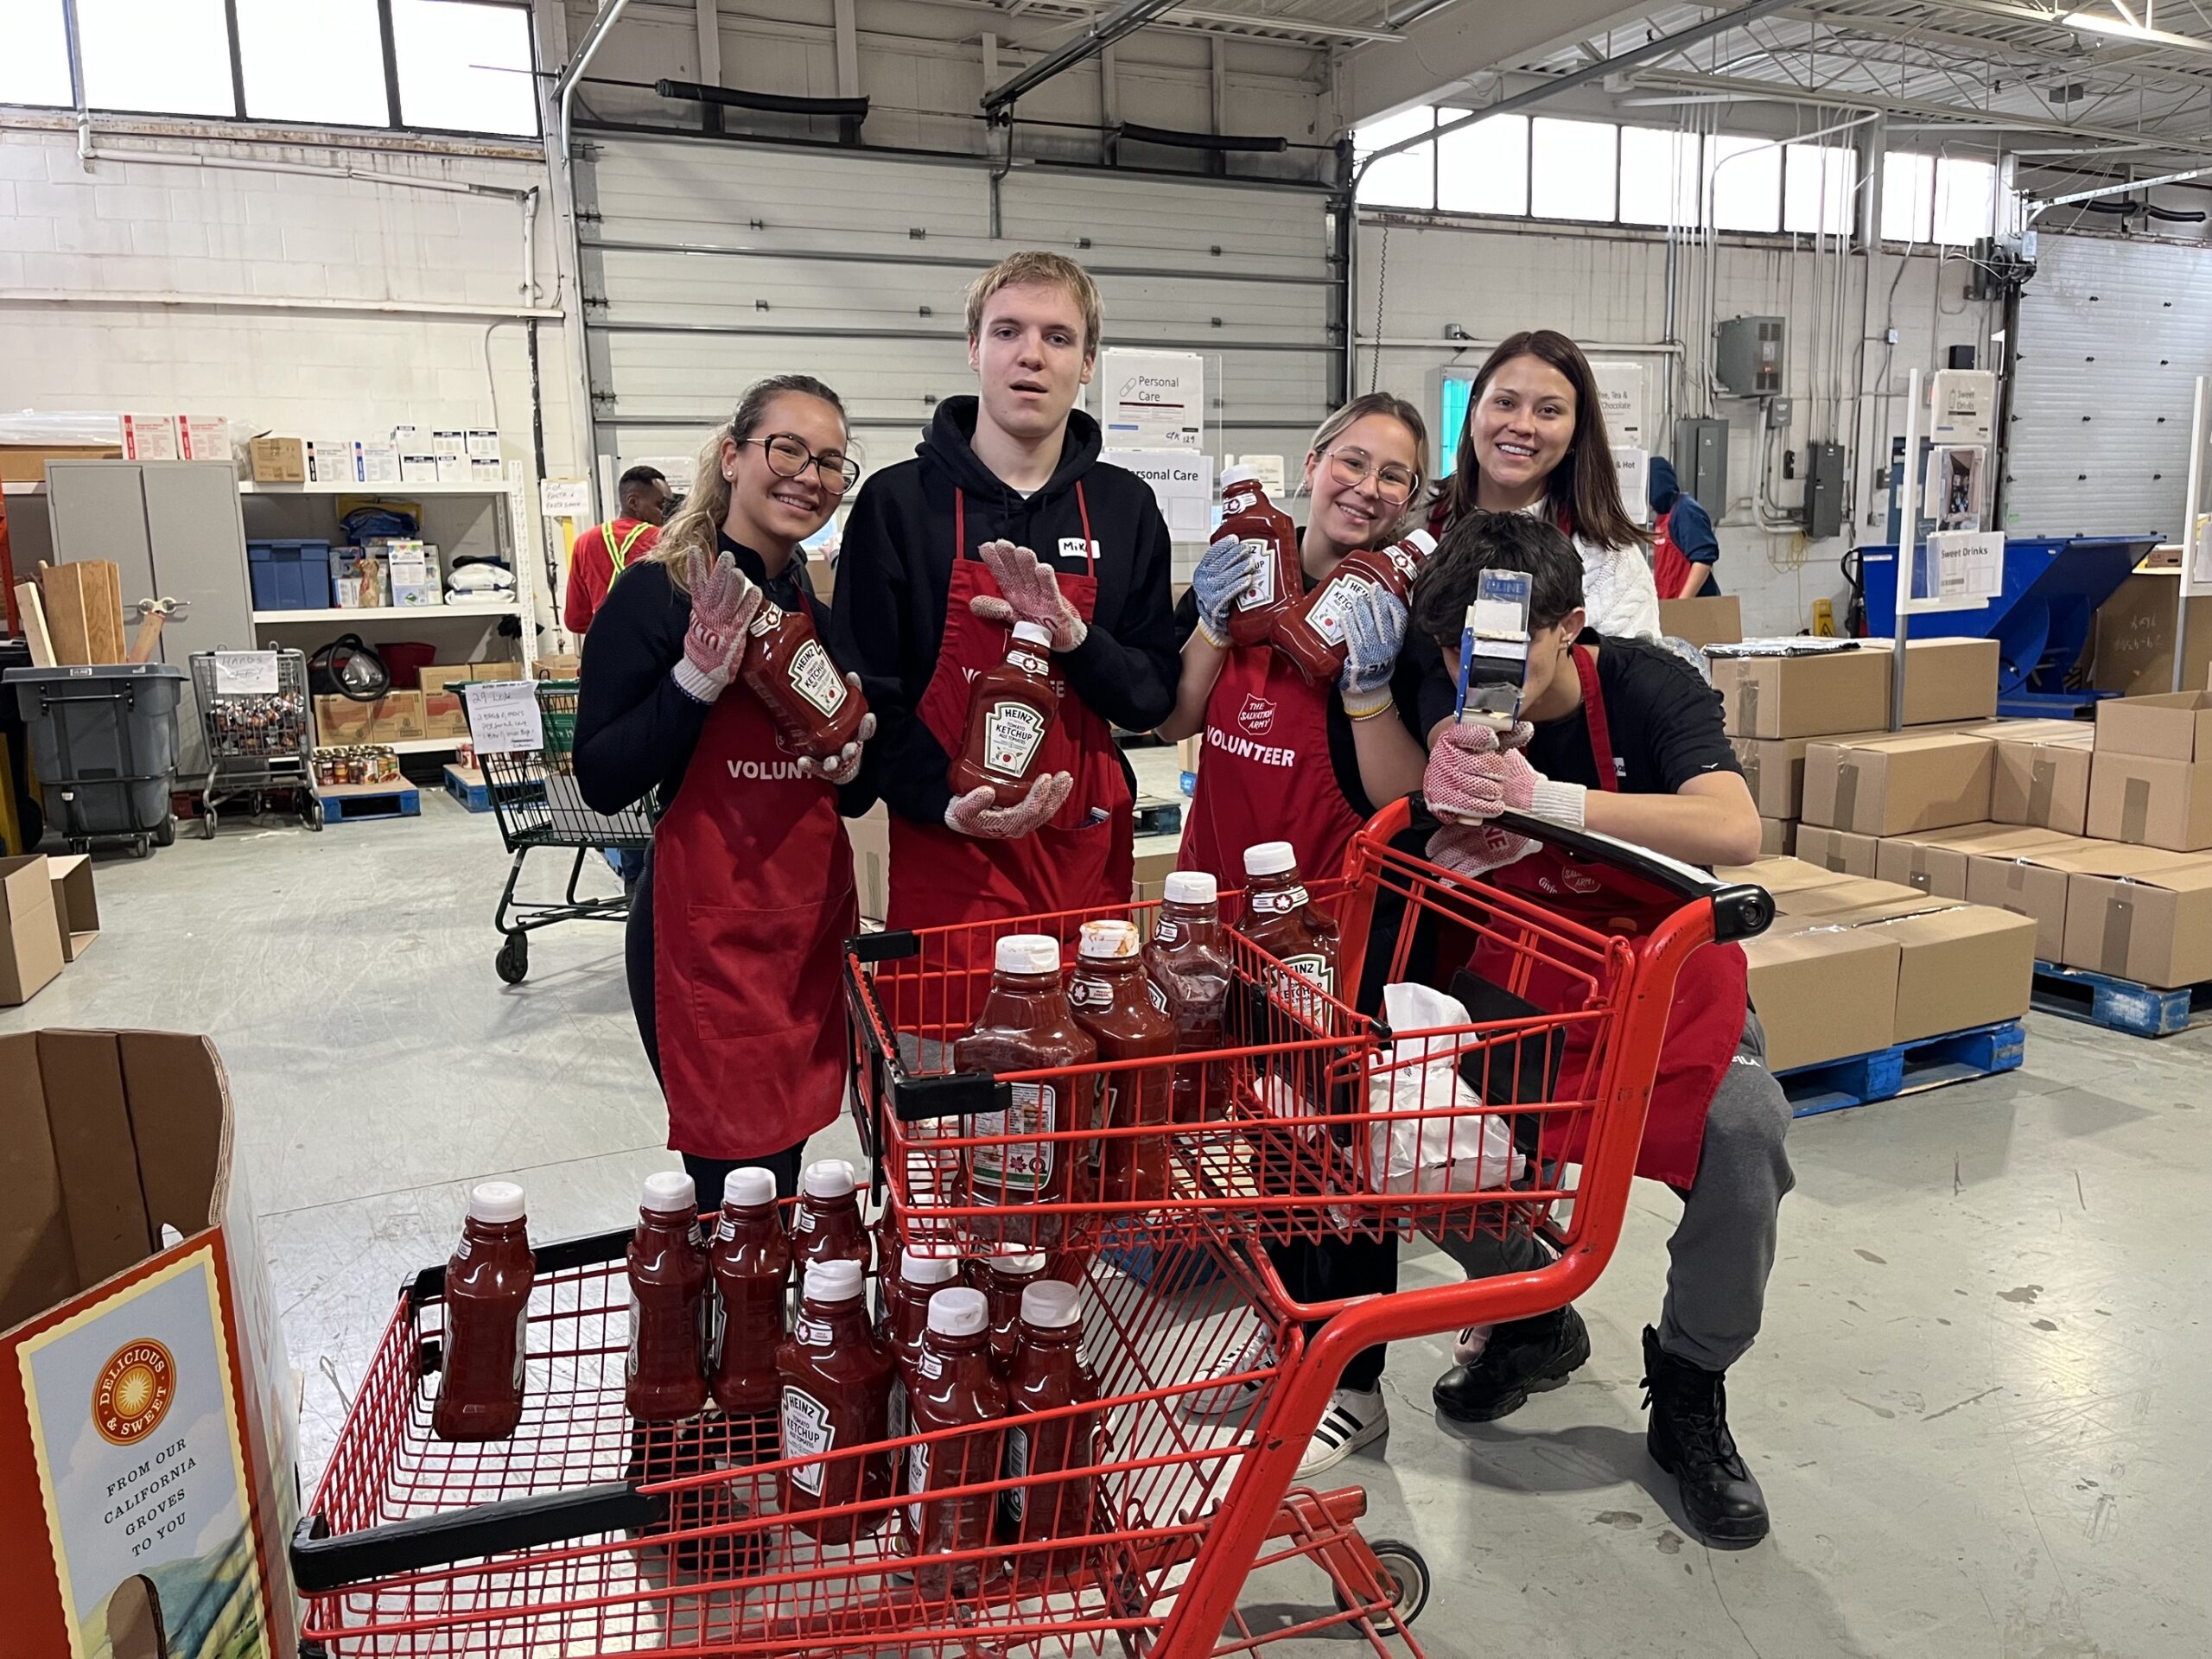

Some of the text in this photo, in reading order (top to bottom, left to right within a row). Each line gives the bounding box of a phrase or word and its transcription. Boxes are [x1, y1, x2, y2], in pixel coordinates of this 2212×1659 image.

[1139, 376, 1179, 388] Personal
[1139, 391, 1160, 402] Care
[1611, 391, 1622, 399] Tea
[1623, 391, 1628, 399] &
[1623, 461, 1635, 469] Hot
[1173, 469, 1198, 481] Care
[1941, 546, 1988, 559] Sweet Drinks
[797, 648, 815, 671] HEINZ
[804, 659, 825, 688] KETCHUP
[1005, 709, 1033, 724] HEINZ
[1240, 708, 1274, 721] SALVATION
[996, 724, 1033, 741] KETCHUP
[1007, 721, 1026, 731] TOMATO
[1248, 719, 1271, 730] ARMY
[1206, 725, 1295, 767] VOLUNTEER
[1574, 878, 1595, 887] ARM
[99, 1349, 167, 1406] DELICIOUS
[105, 1386, 168, 1436] & SWEET
[789, 1395, 815, 1419] HEINZ
[786, 1416, 820, 1443] KETCHUP
[792, 1414, 810, 1429] TOMATO
[106, 1439, 188, 1498] FROM OUR
[104, 1457, 197, 1525] CALIFORNIA
[124, 1488, 187, 1537] GROVES
[131, 1512, 188, 1557] TO YOU
